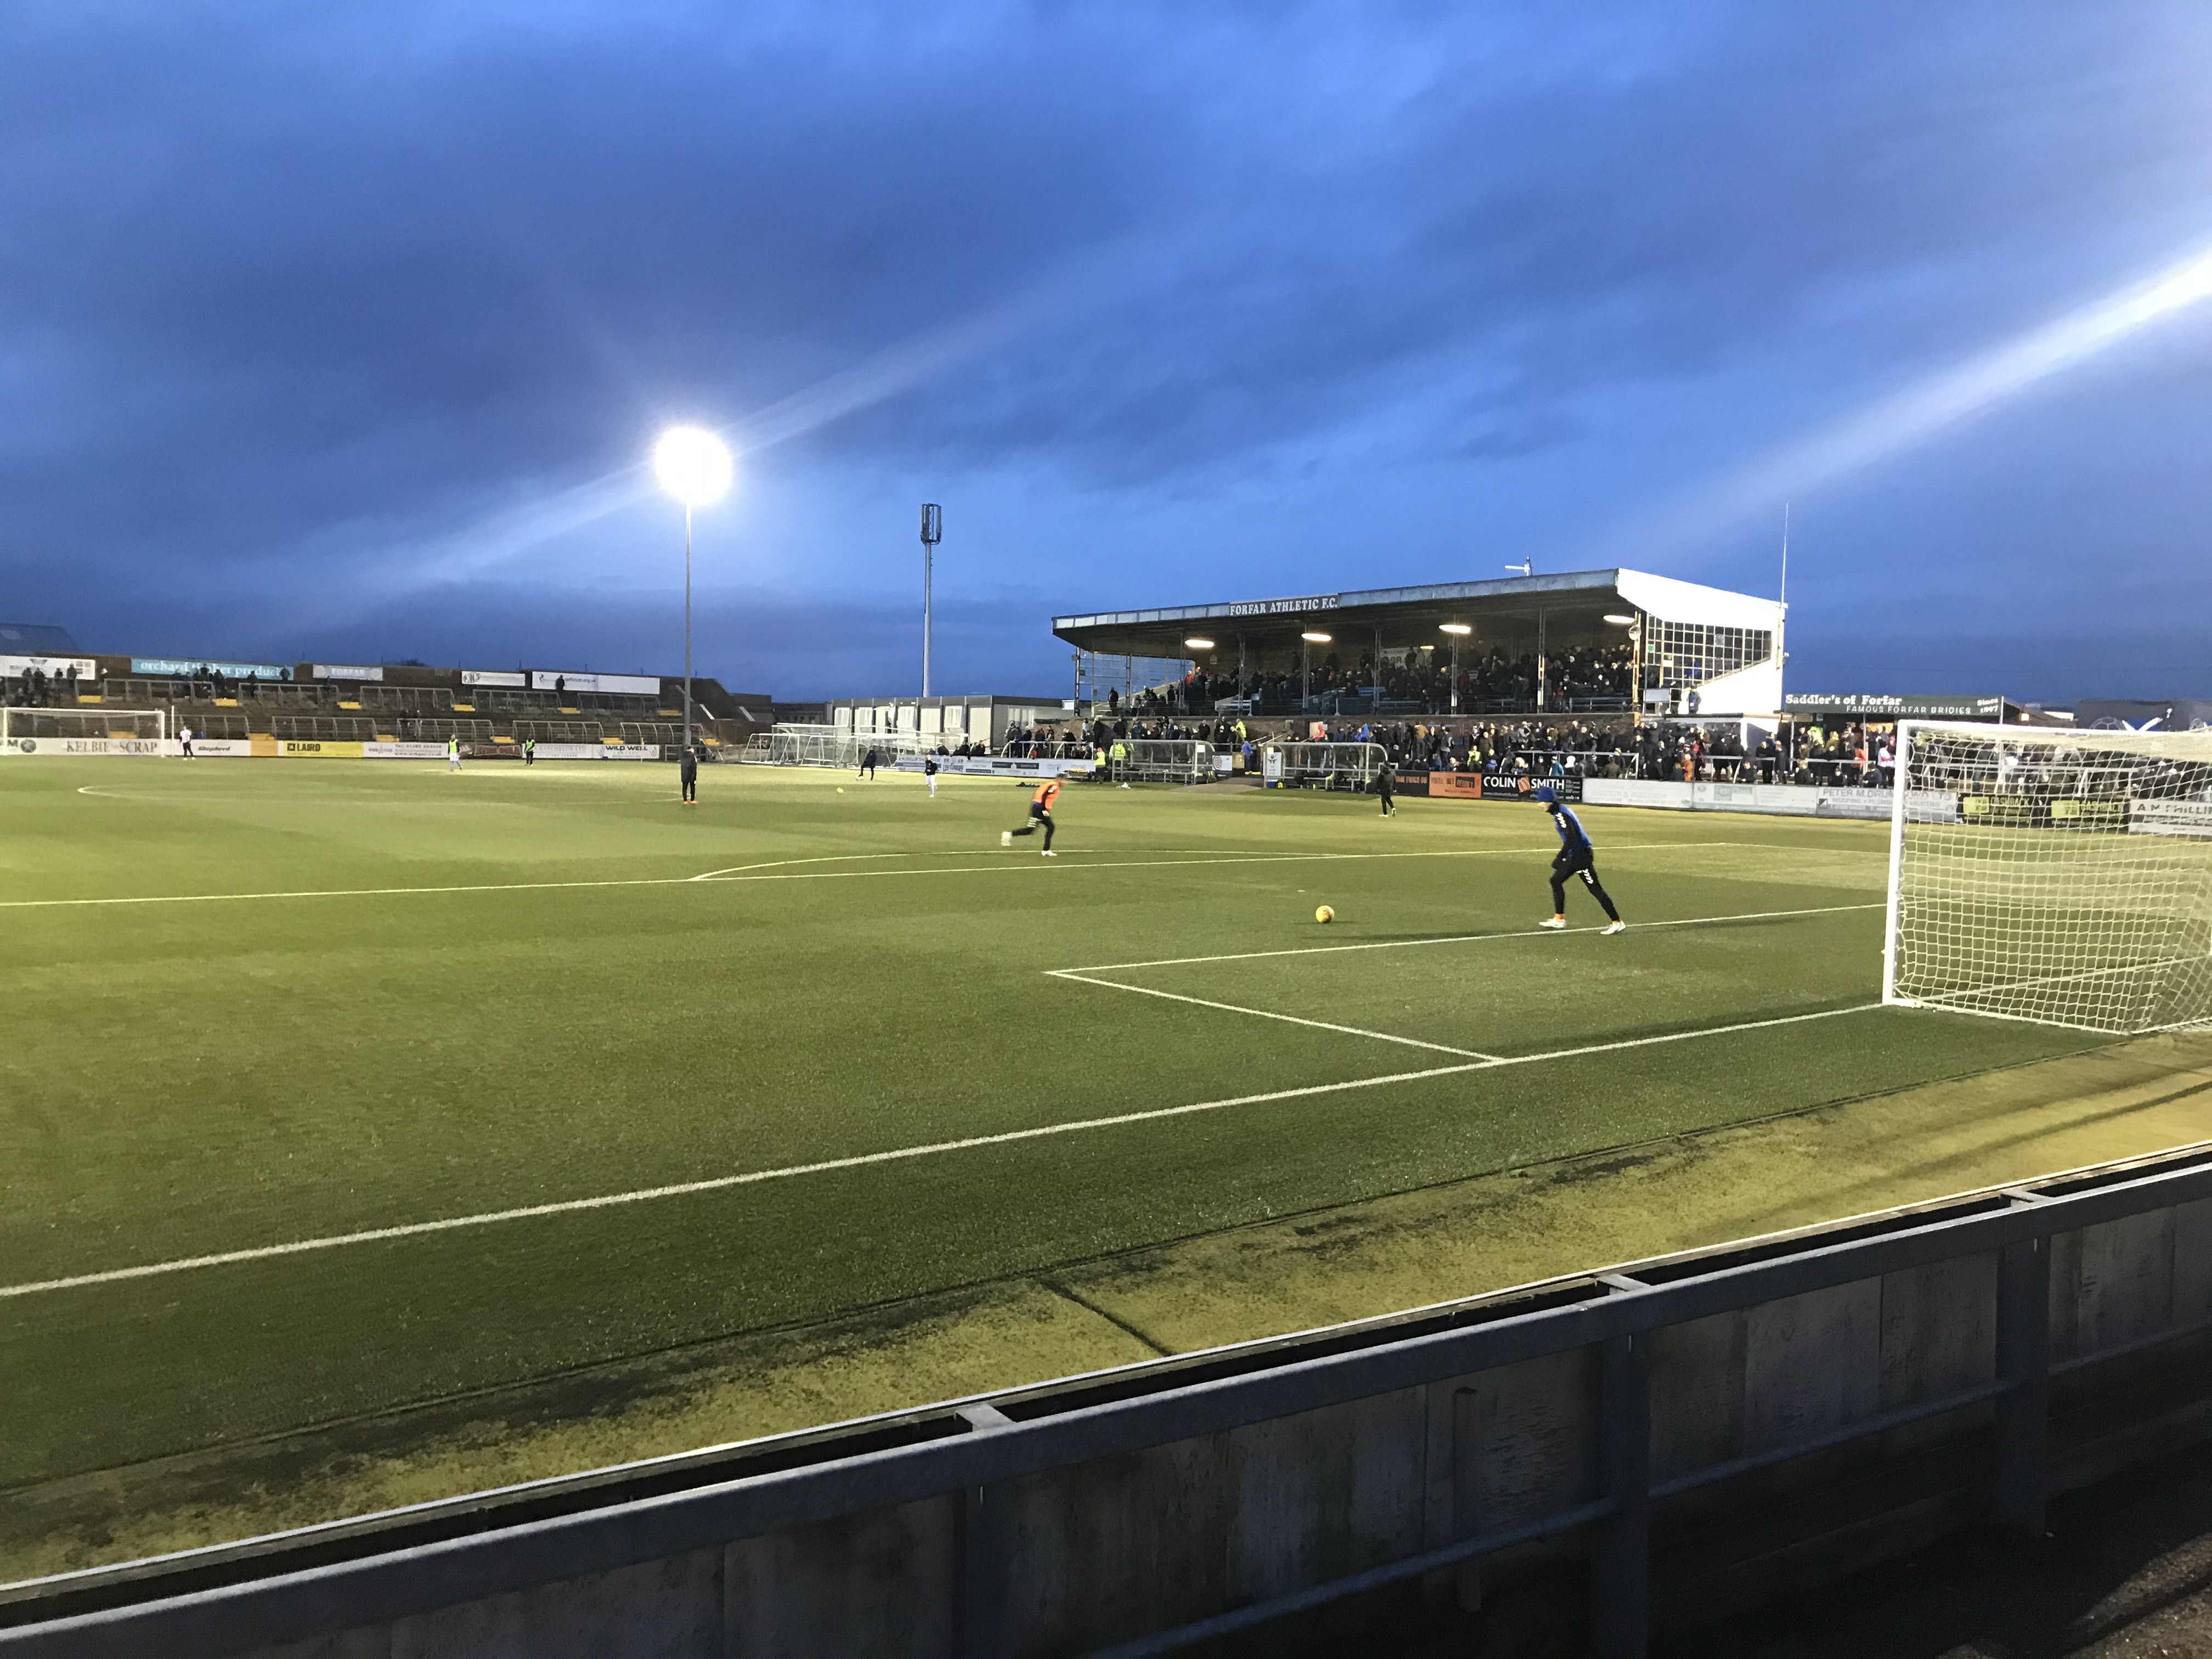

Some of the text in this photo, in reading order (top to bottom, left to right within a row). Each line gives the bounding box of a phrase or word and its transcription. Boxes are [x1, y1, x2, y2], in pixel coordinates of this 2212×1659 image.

[1230, 597, 1338, 616] FORFAR ATHLETIC F.C.
[140, 660, 189, 673] orchard
[1785, 695, 1902, 705] Saddler's of Forfar
[66, 741, 157, 753] KELBIE SCRAP
[297, 743, 321, 752] LAIRD
[1483, 776, 1564, 789] COLIN SMITH
[1823, 788, 1853, 797] PETER
